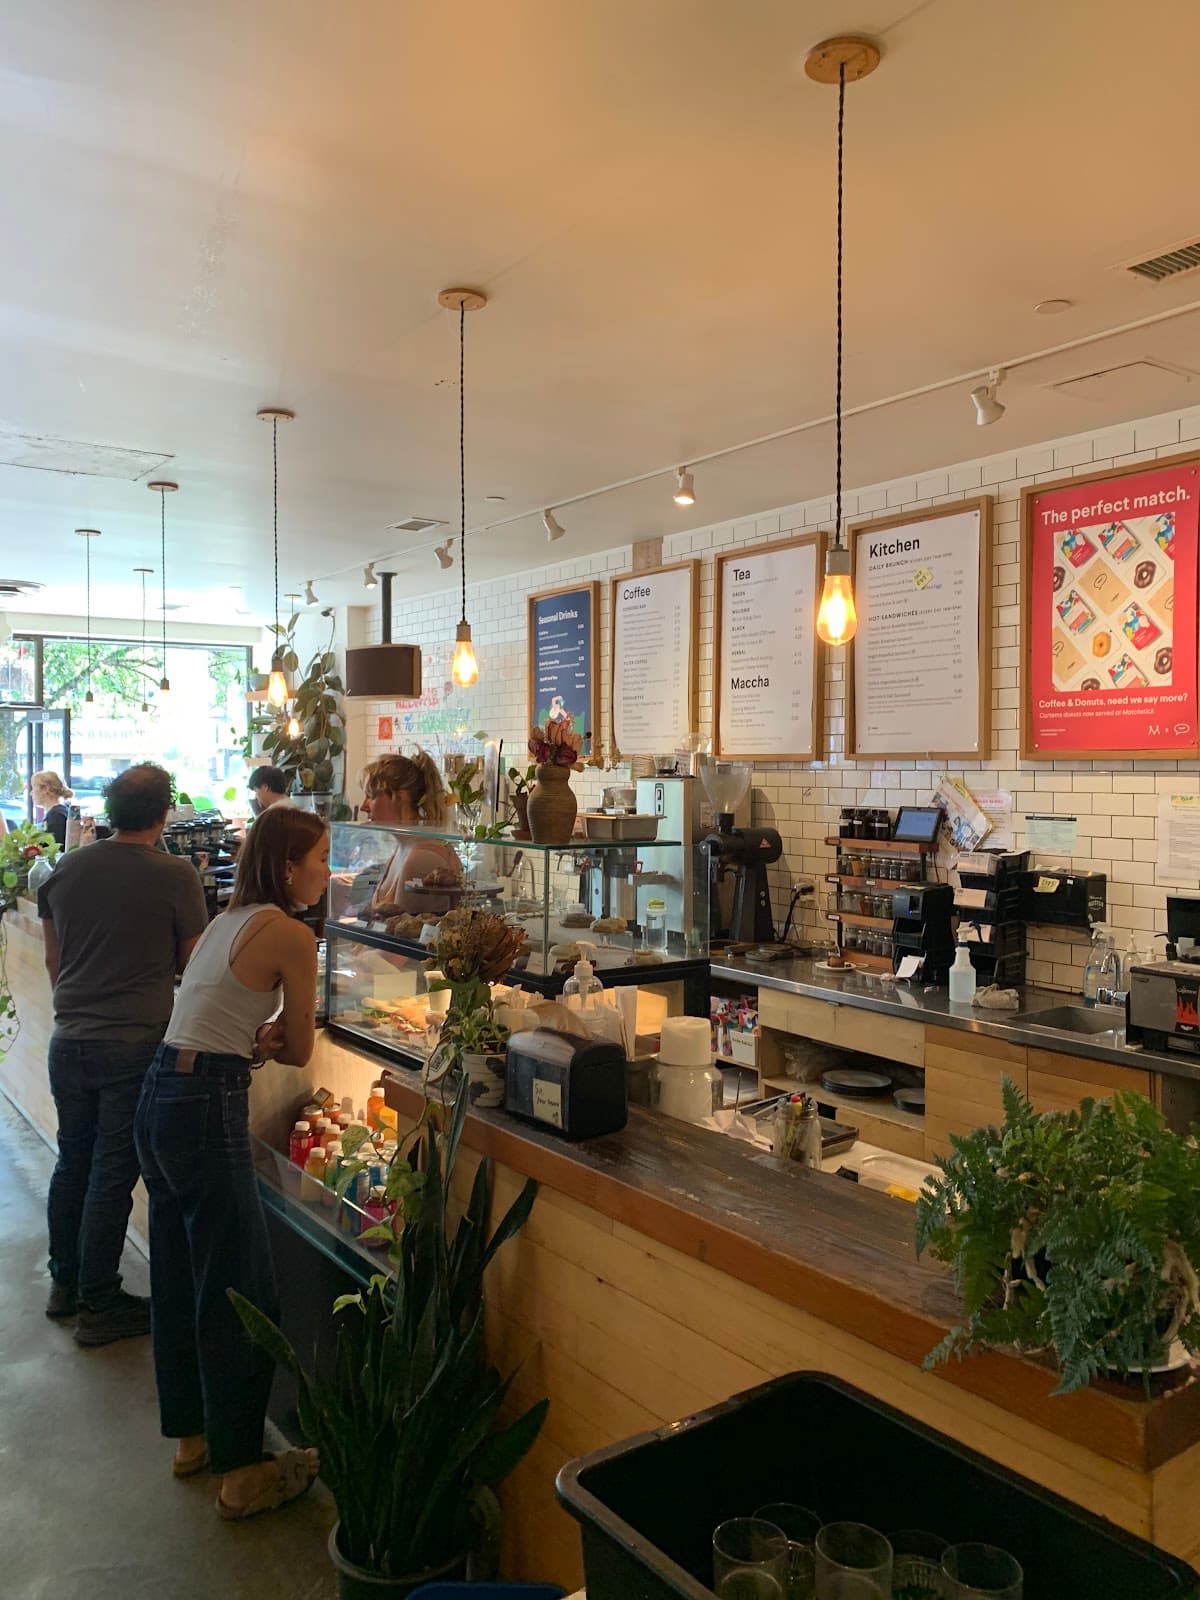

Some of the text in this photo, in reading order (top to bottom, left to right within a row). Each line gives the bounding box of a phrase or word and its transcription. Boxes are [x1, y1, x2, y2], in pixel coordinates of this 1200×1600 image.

[1042, 485, 1190, 525] The perfect match.
[869, 538, 920, 558] Kitchen
[732, 569, 751, 581] Tea
[623, 586, 651, 600] Coffee
[559, 609, 578, 620] Drinks
[881, 610, 918, 620] SANDWICHES
[731, 675, 770, 690] Maccha
[1039, 699, 1066, 709] Coffee
[1067, 699, 1074, 707] &
[1075, 698, 1106, 707] Donuts,
[1107, 696, 1129, 705] need
[1144, 697, 1158, 705] say
[1160, 693, 1188, 703] more?
